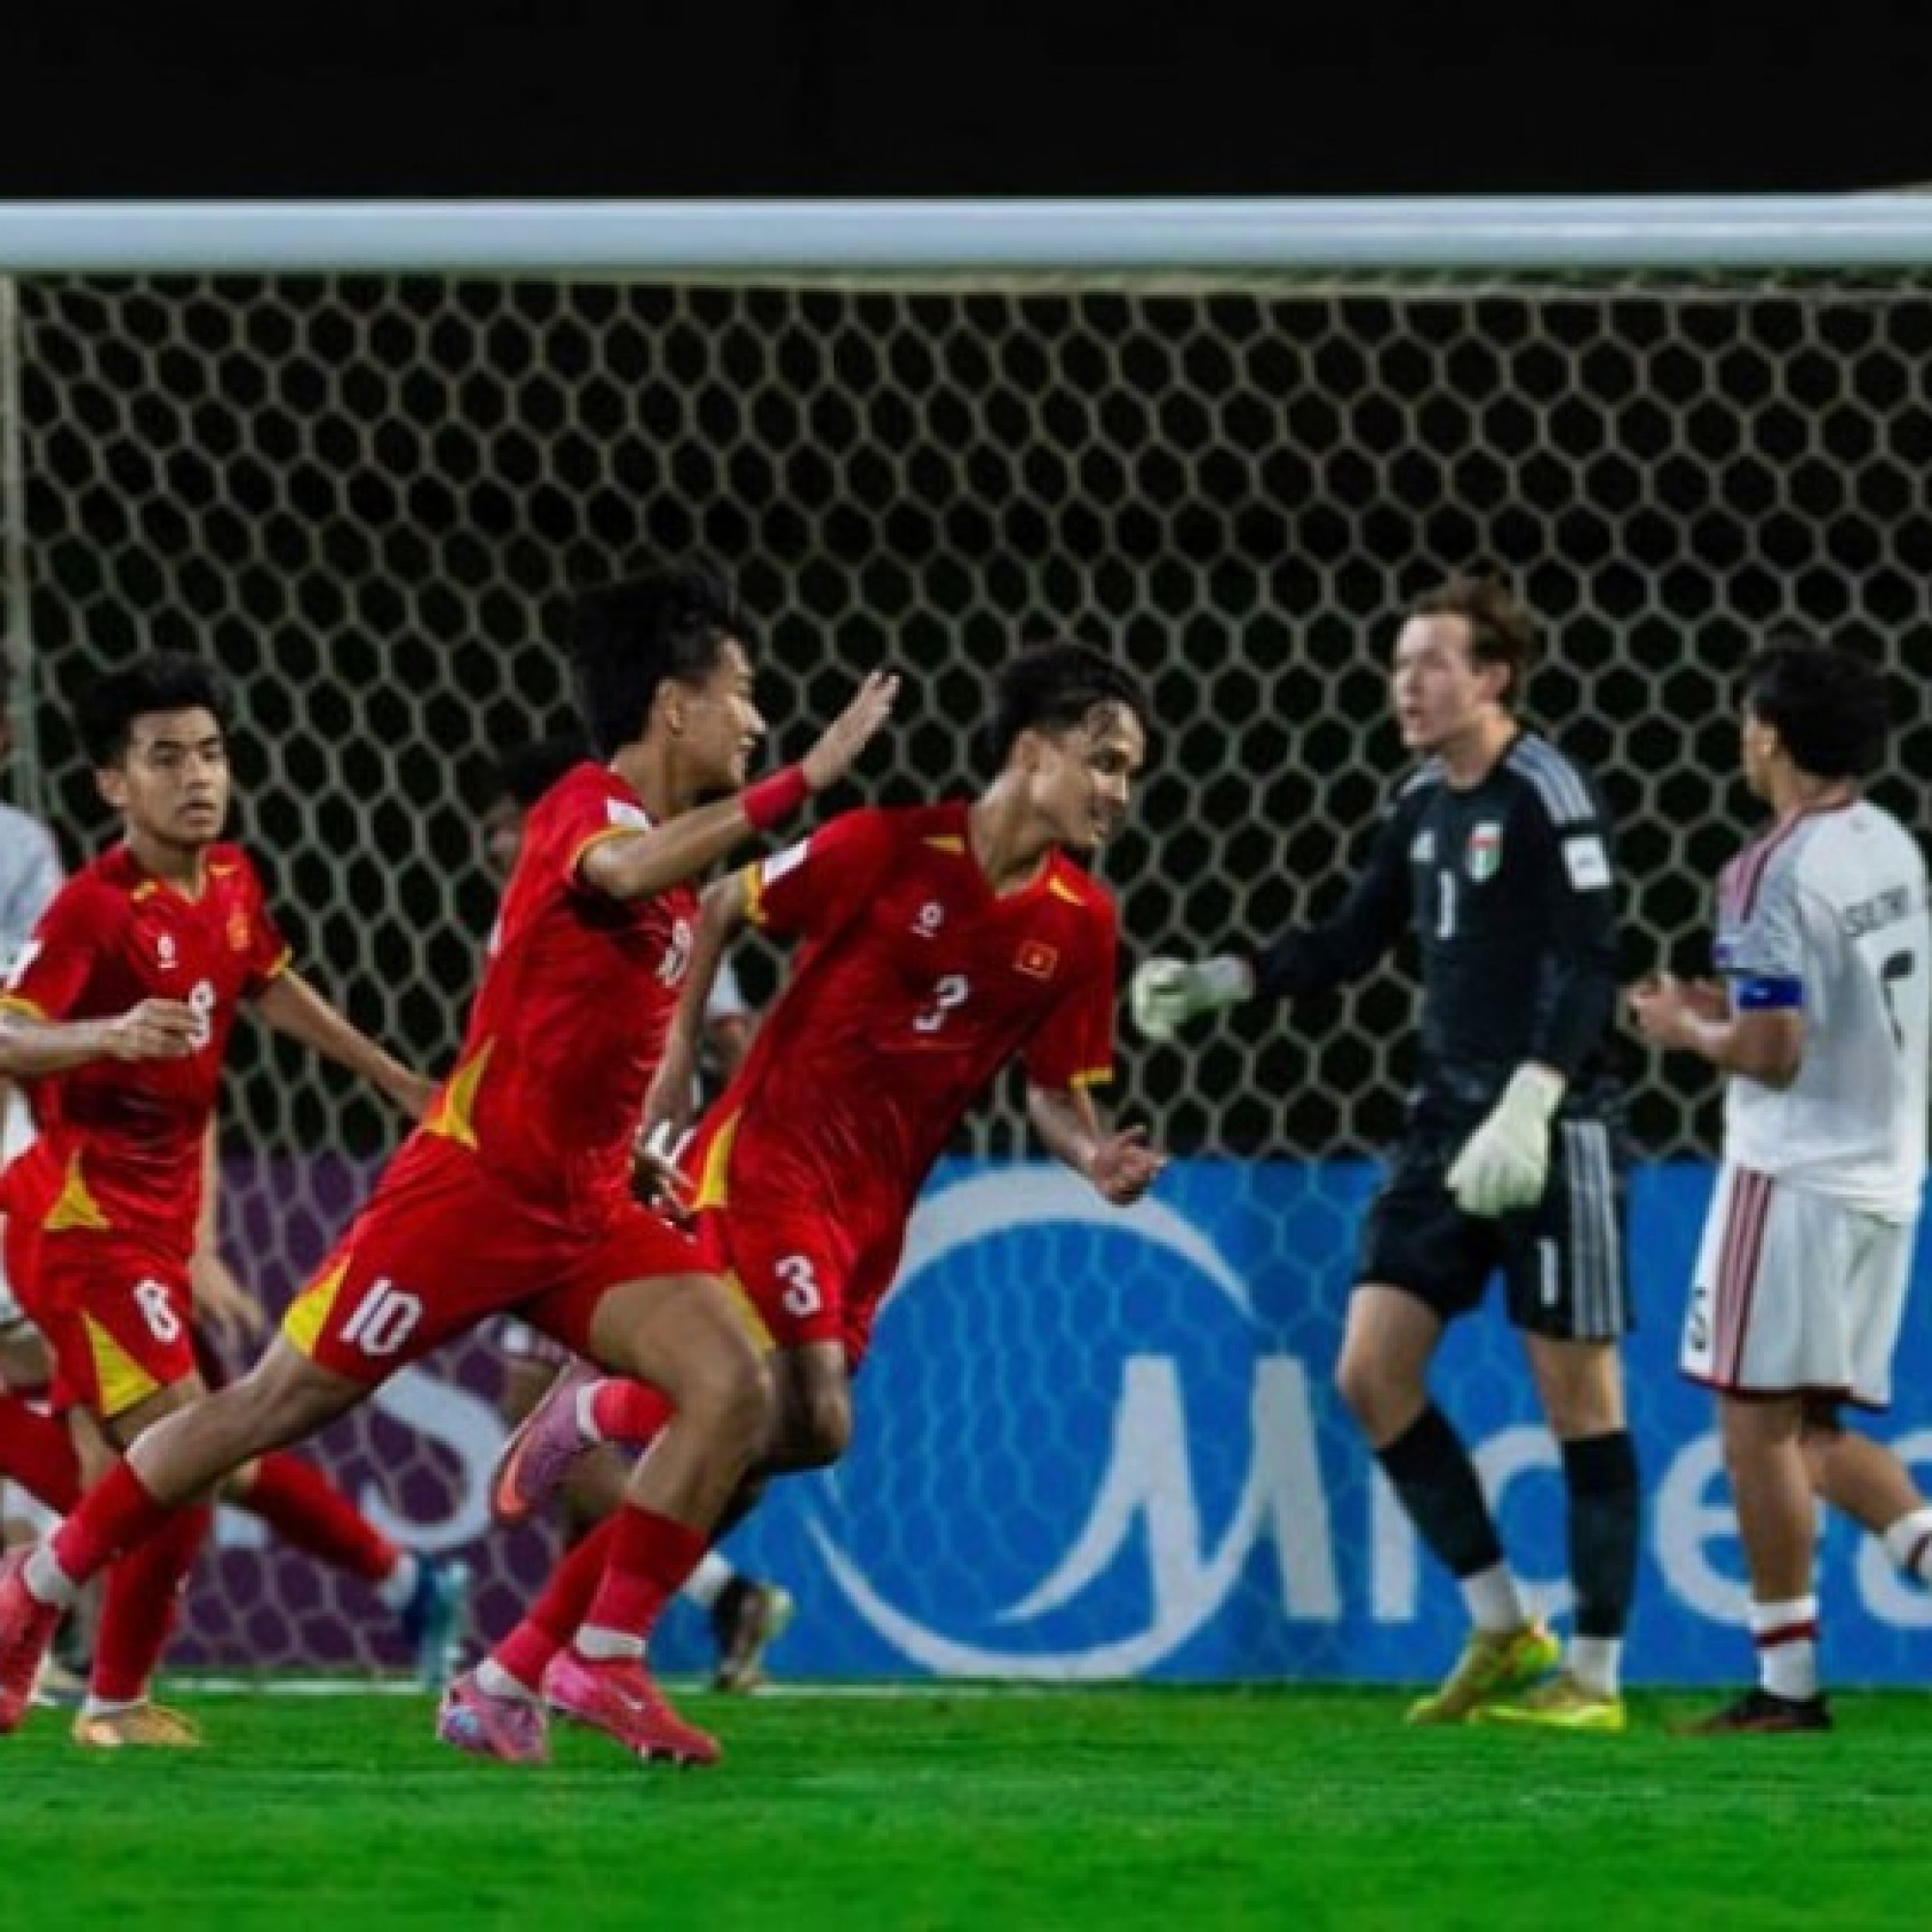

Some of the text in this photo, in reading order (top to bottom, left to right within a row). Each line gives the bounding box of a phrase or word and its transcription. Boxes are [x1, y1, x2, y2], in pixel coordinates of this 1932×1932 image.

[1435, 869, 1457, 940] 1
[775, 1254, 821, 1317] 3
[1534, 1236, 1559, 1307] 1
[339, 1276, 424, 1356] 10
